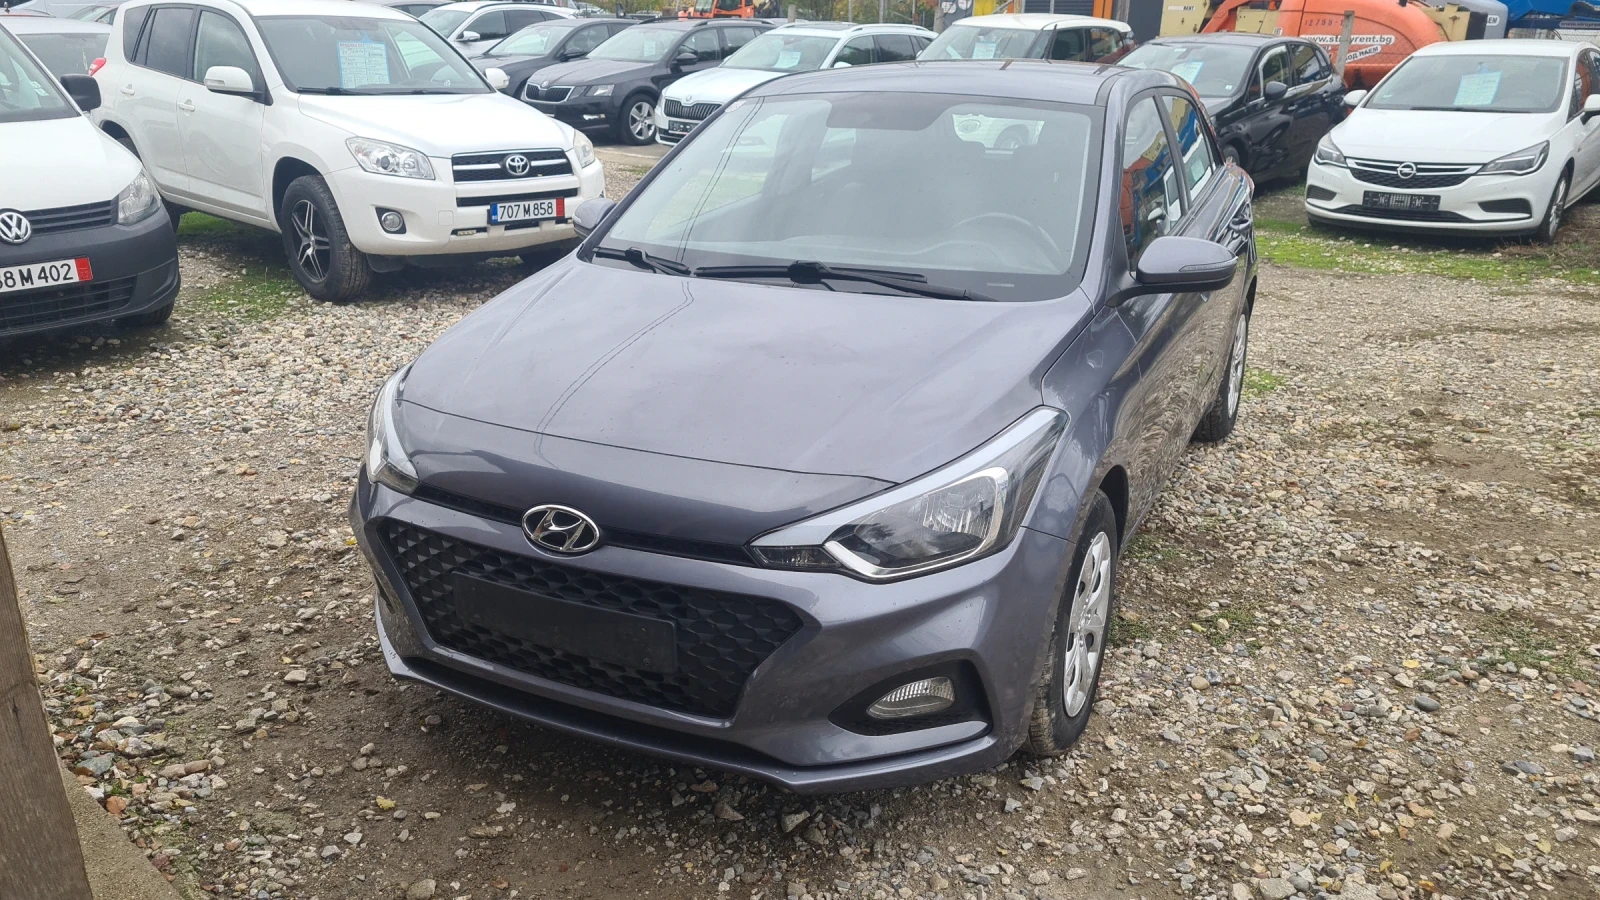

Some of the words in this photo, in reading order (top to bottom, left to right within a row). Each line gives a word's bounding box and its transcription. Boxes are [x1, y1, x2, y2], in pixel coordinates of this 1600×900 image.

[1346, 52, 1358, 61] ОД
[500, 204, 520, 220] 707
[523, 203, 531, 218] M
[533, 202, 554, 217] 858
[18, 267, 34, 287] M
[37, 263, 74, 283] 402
